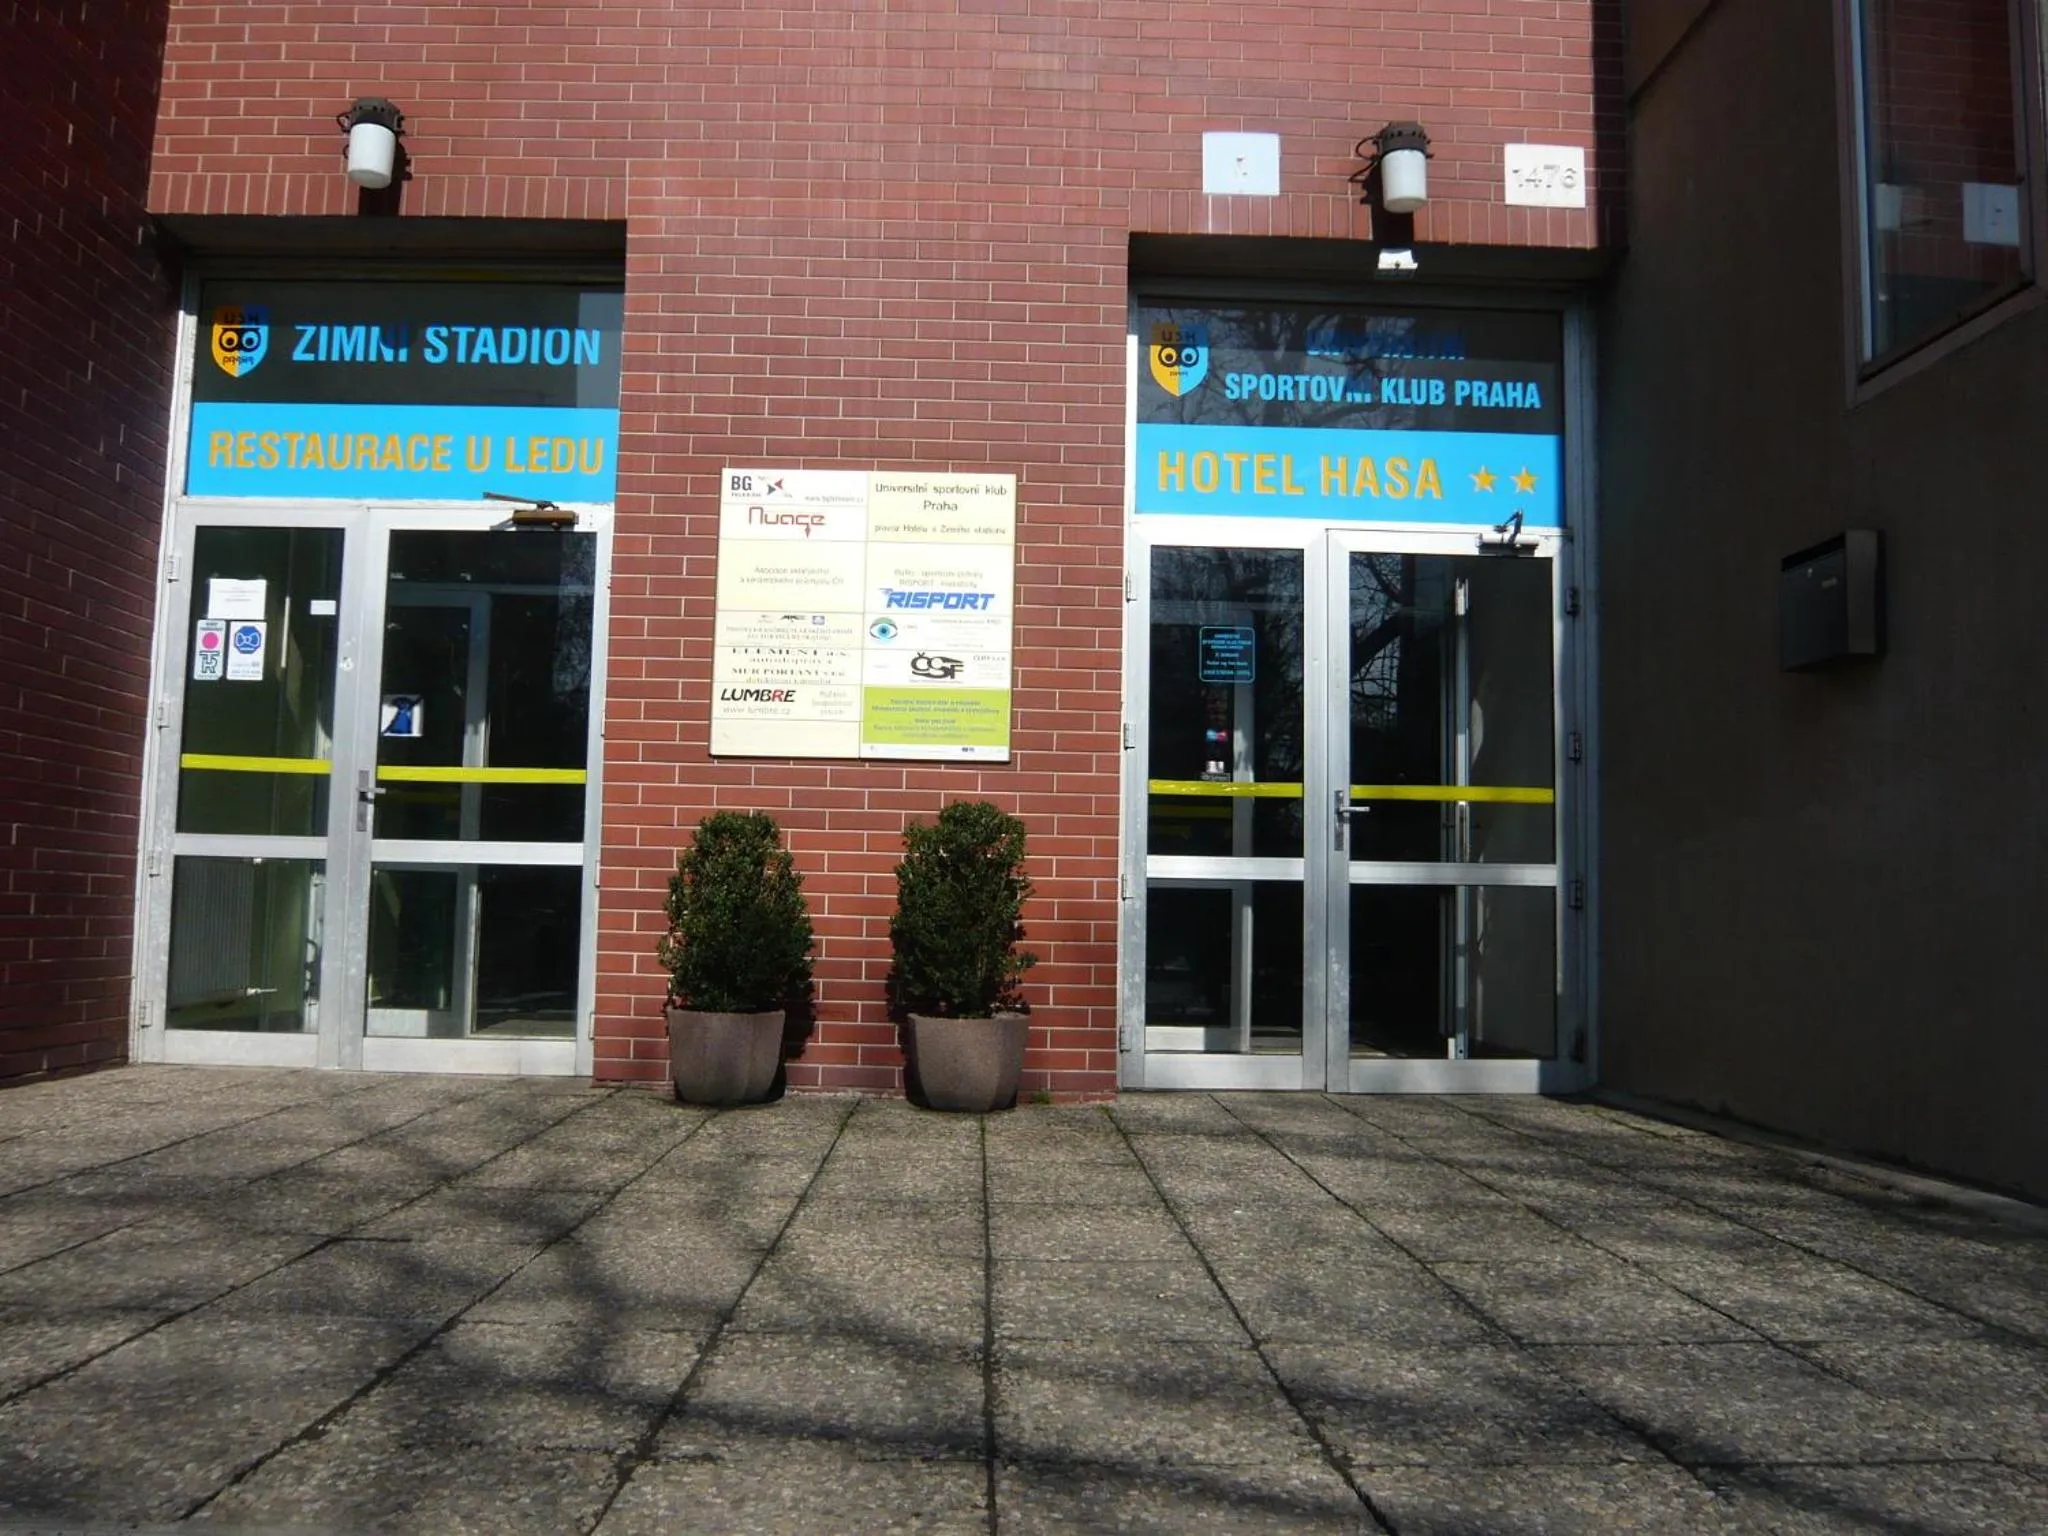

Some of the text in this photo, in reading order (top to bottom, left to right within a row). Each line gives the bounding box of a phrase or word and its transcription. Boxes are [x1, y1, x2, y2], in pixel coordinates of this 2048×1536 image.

[424, 325, 601, 366] STADION
[1380, 378, 1446, 405] KLUB
[1455, 379, 1541, 410] PRAHA
[208, 430, 605, 474] RESTAURACE U LEDU
[731, 475, 752, 491] BG
[1157, 450, 1443, 499] HOTEL HASA
[923, 500, 958, 512] Praha
[886, 591, 995, 610] RISPORT
[720, 687, 796, 703] LUMBRE
